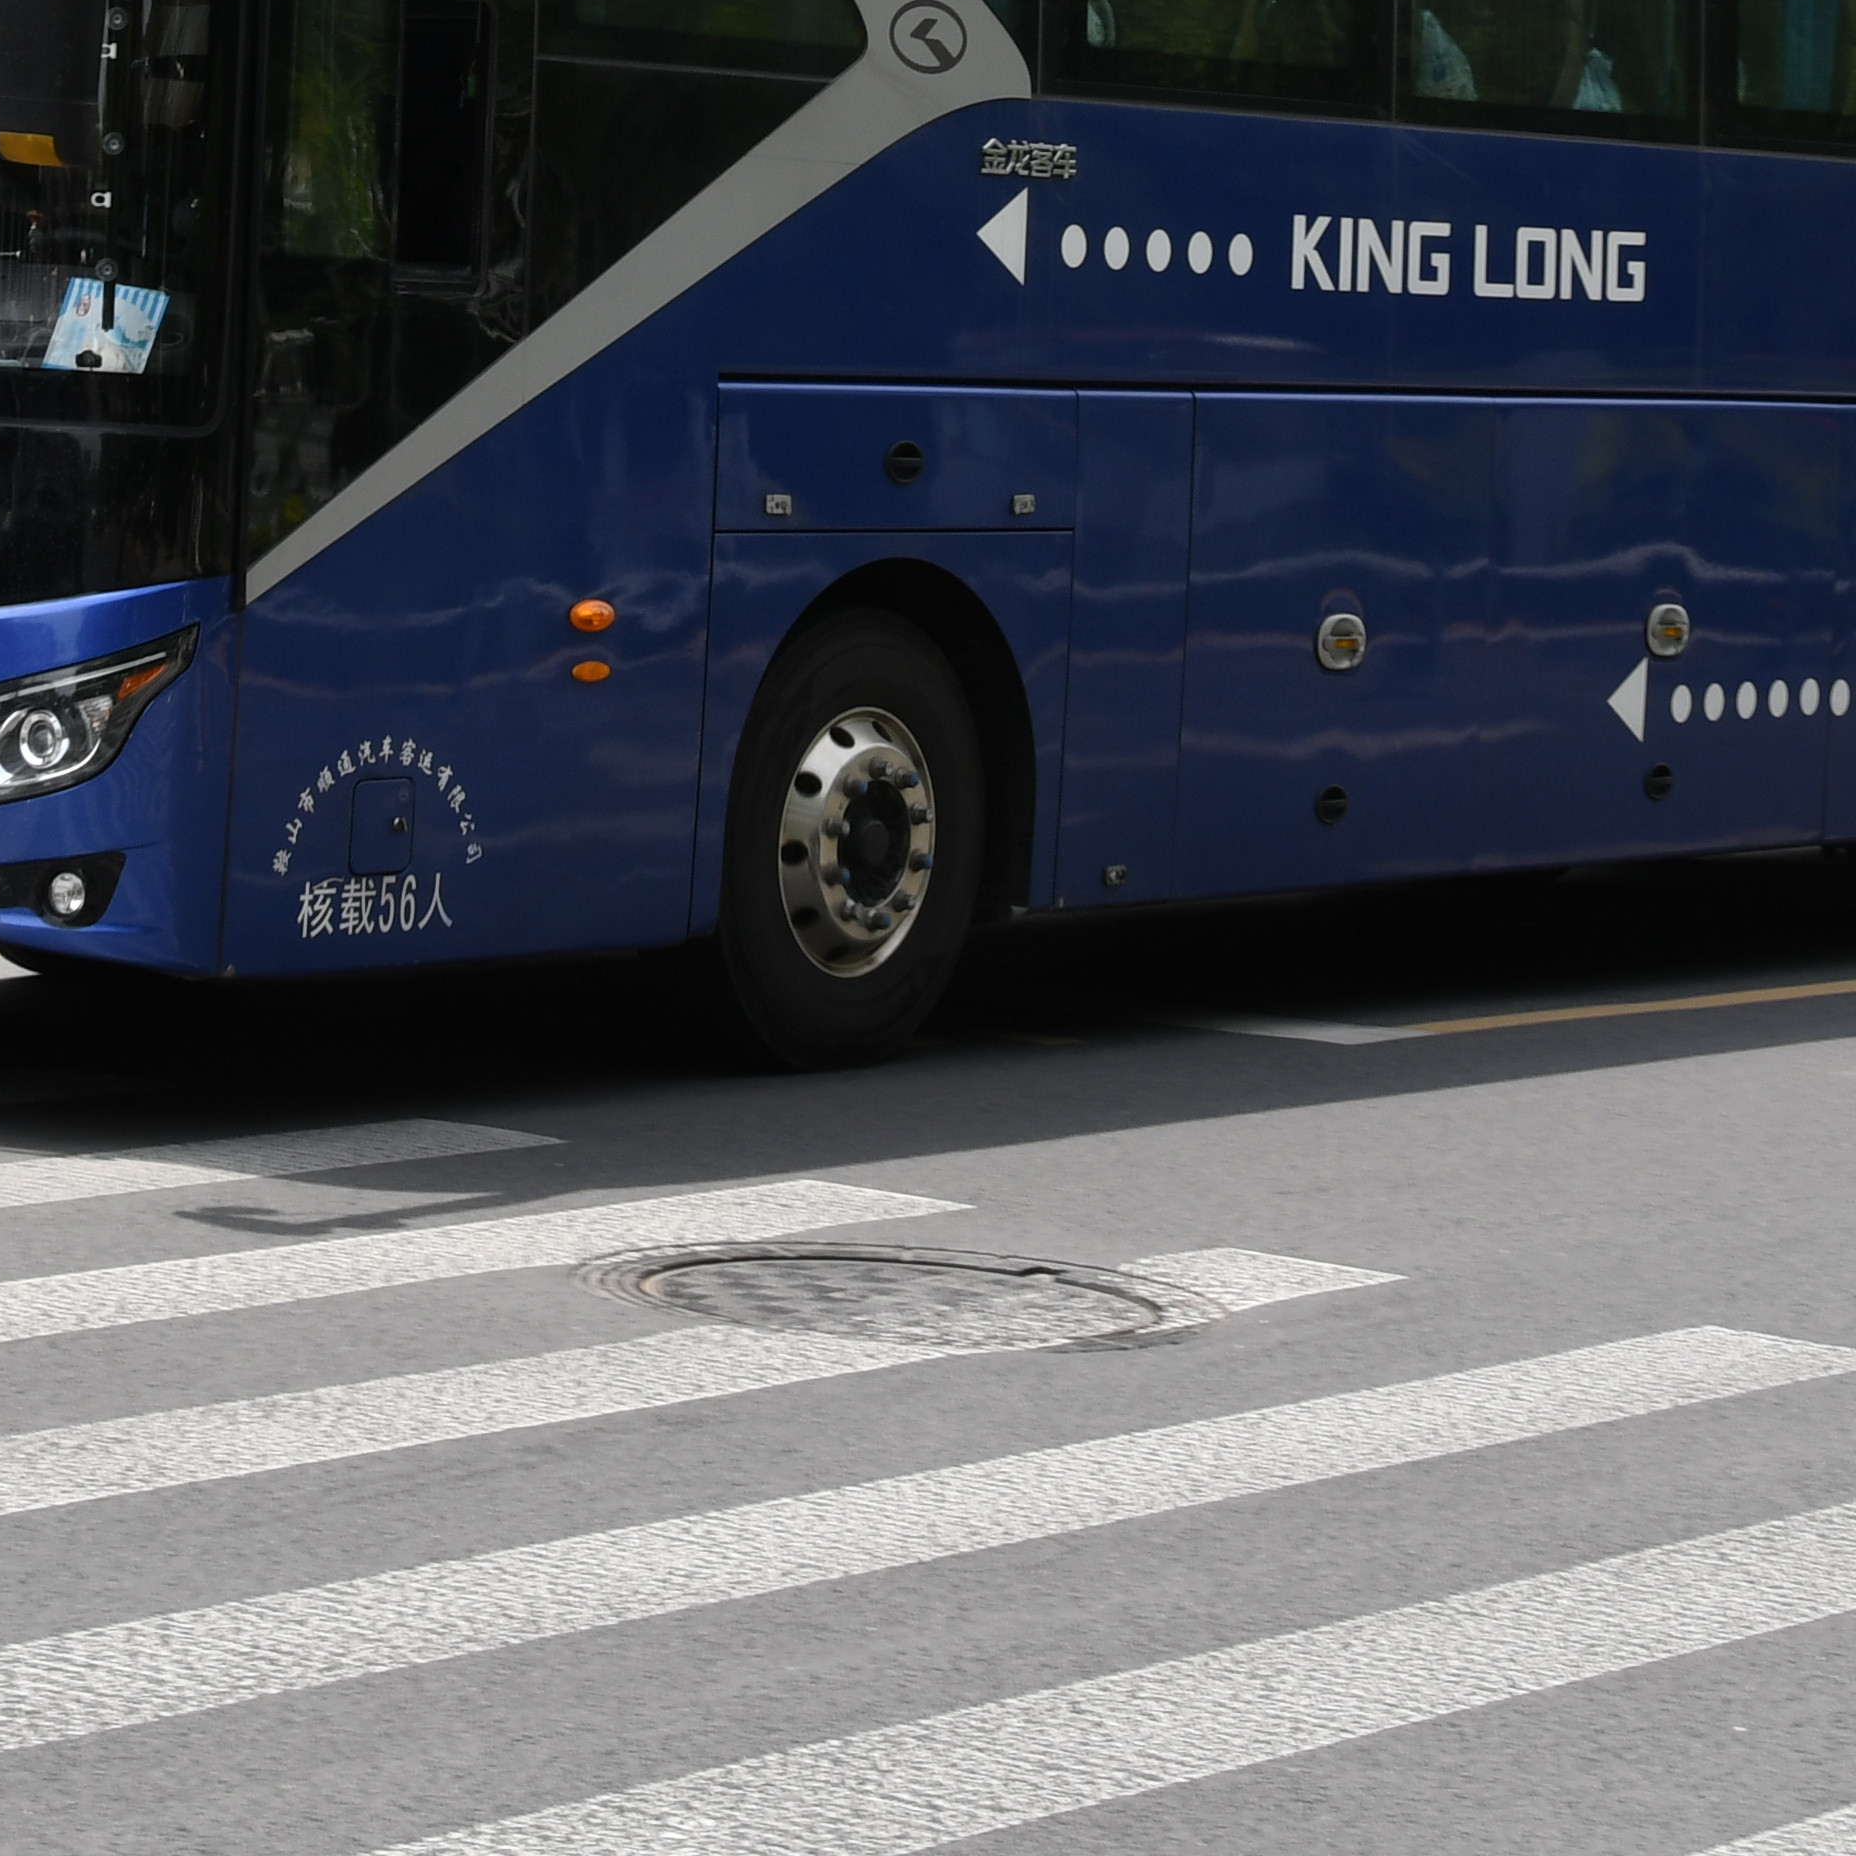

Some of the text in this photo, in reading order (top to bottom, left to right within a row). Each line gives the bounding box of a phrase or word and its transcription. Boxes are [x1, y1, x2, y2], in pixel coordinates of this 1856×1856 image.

[981, 137, 1077, 179] 金龙客车
[1291, 214, 1646, 302] KING LONG
[297, 872, 453, 938] 核载56人
